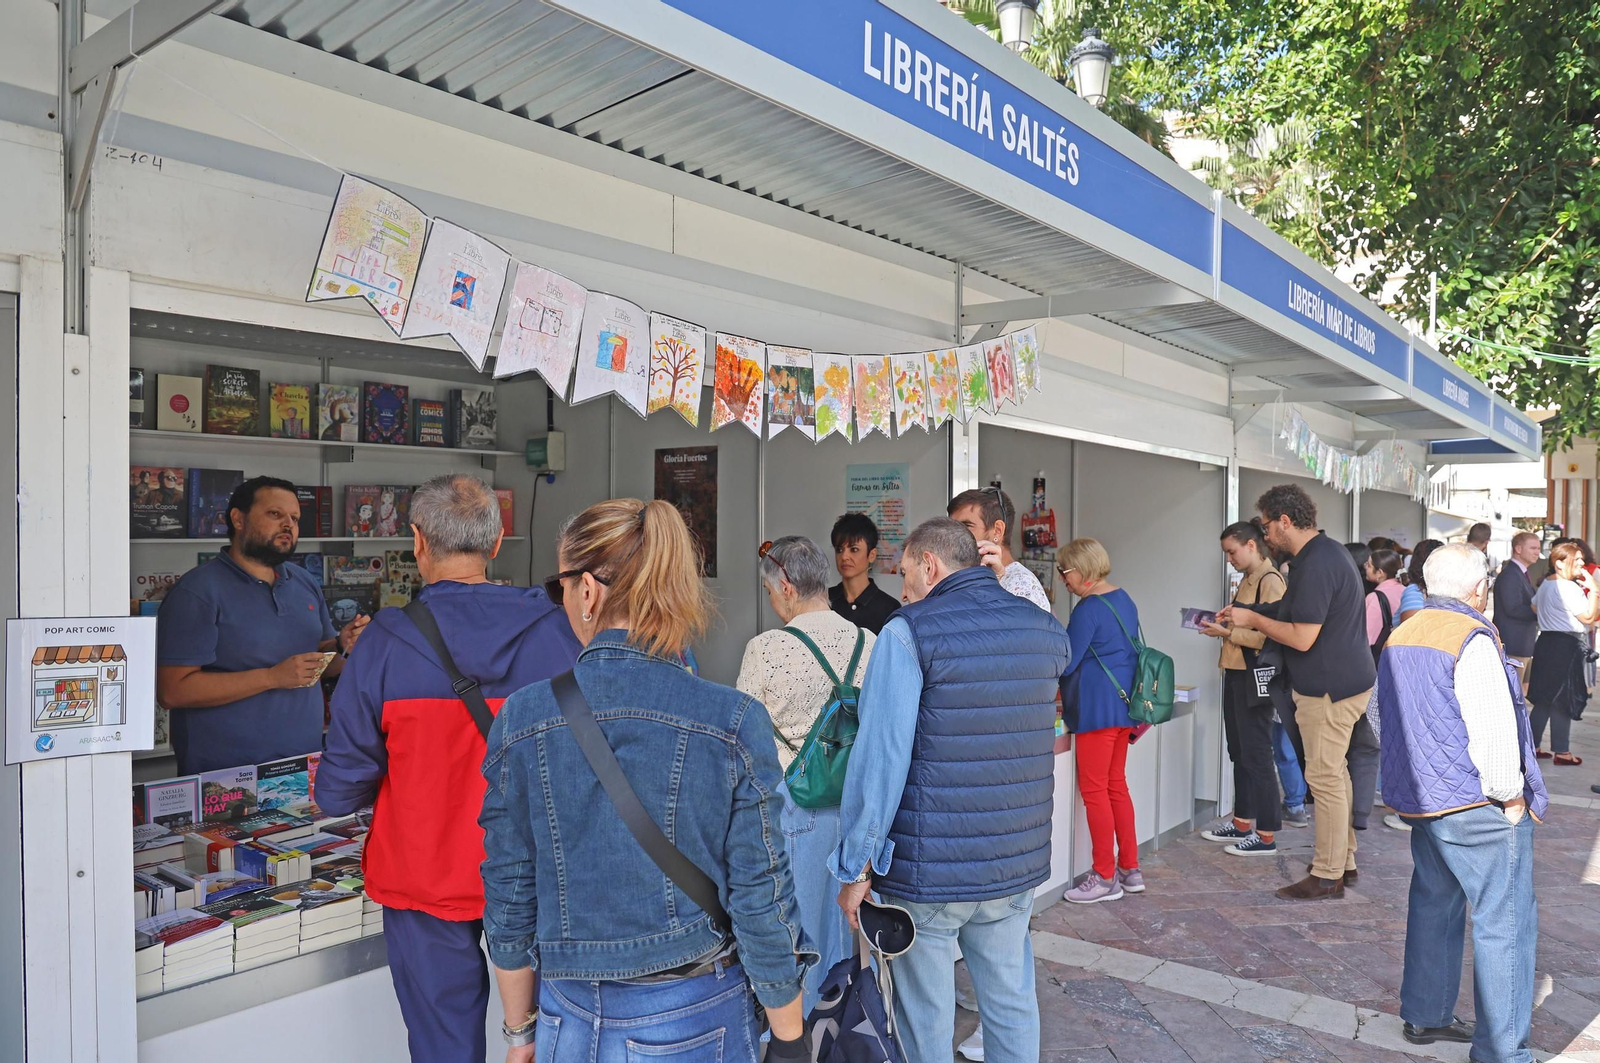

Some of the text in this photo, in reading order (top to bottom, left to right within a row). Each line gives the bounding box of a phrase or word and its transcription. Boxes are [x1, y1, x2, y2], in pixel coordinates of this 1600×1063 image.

[863, 20, 1080, 186] LIBRERÍA SALTÉS
[1288, 280, 1376, 355] LIBRERÍA MAR DE LIBROS
[280, 392, 304, 400] Chavela
[664, 453, 708, 463] Gloria Fuertes
[79, 736, 111, 745] ARASAAC
[204, 791, 243, 805] LO QUE
[204, 803, 227, 815] HAY
